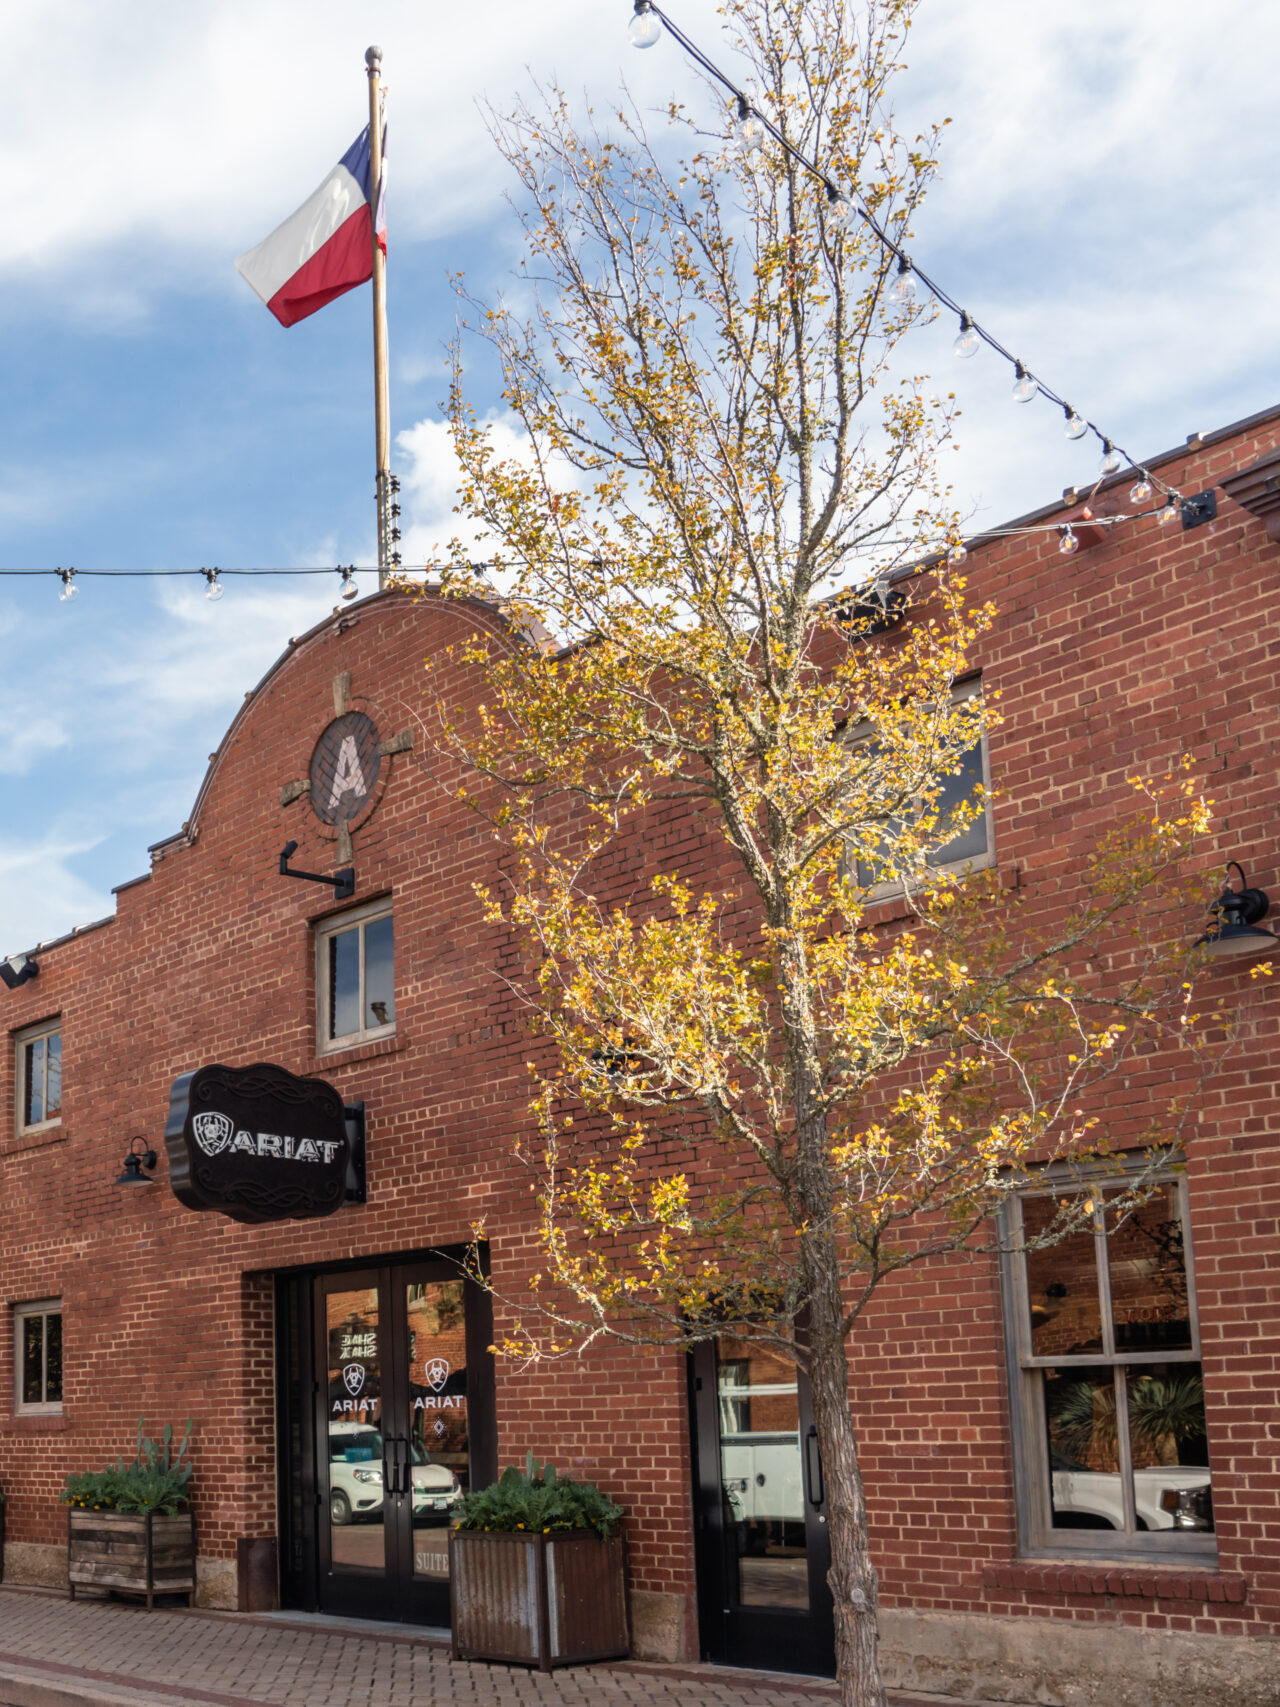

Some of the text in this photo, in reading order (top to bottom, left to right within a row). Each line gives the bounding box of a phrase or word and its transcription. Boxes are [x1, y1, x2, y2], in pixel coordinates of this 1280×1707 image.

[328, 735, 368, 810] A
[229, 1130, 339, 1164] ARIAT
[332, 1399, 378, 1412] ARIAT
[413, 1395, 463, 1409] ARIAT
[416, 1552, 449, 1572] SUITE
